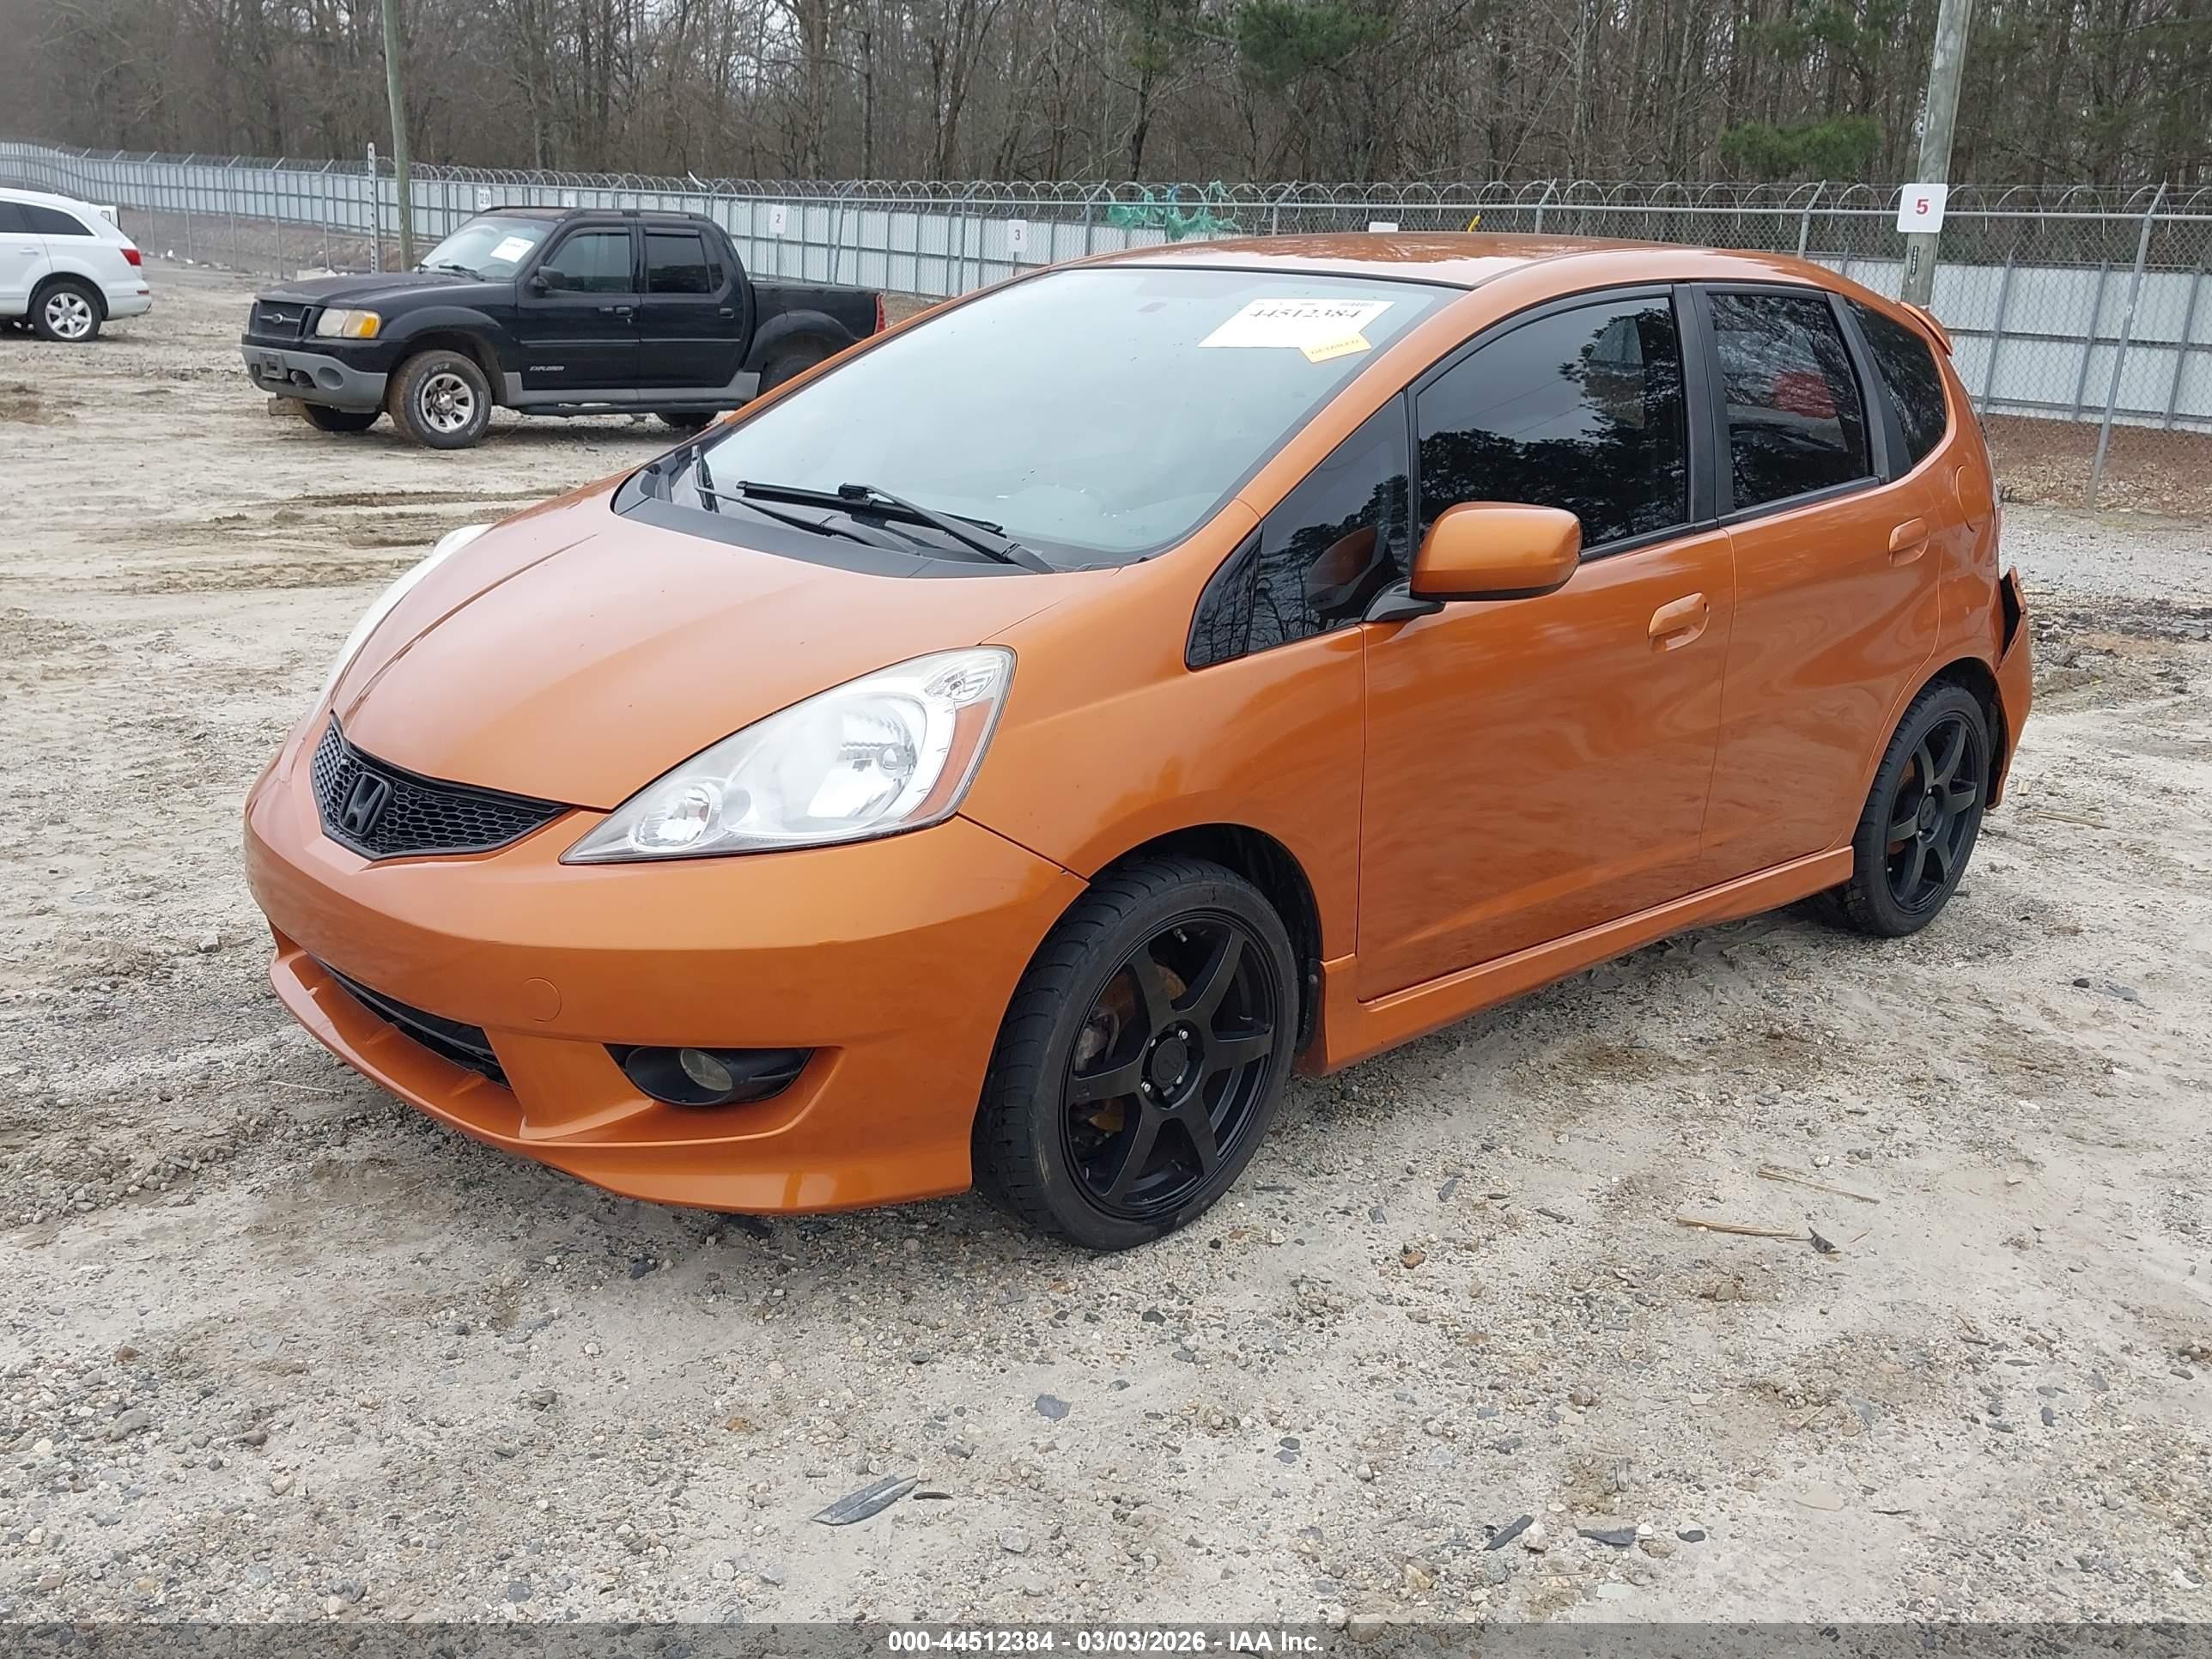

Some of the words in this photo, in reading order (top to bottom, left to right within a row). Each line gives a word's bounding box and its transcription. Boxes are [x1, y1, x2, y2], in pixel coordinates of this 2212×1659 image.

[1916, 199, 1929, 215] 5
[775, 213, 781, 223] 2
[1015, 229, 1021, 240] 3
